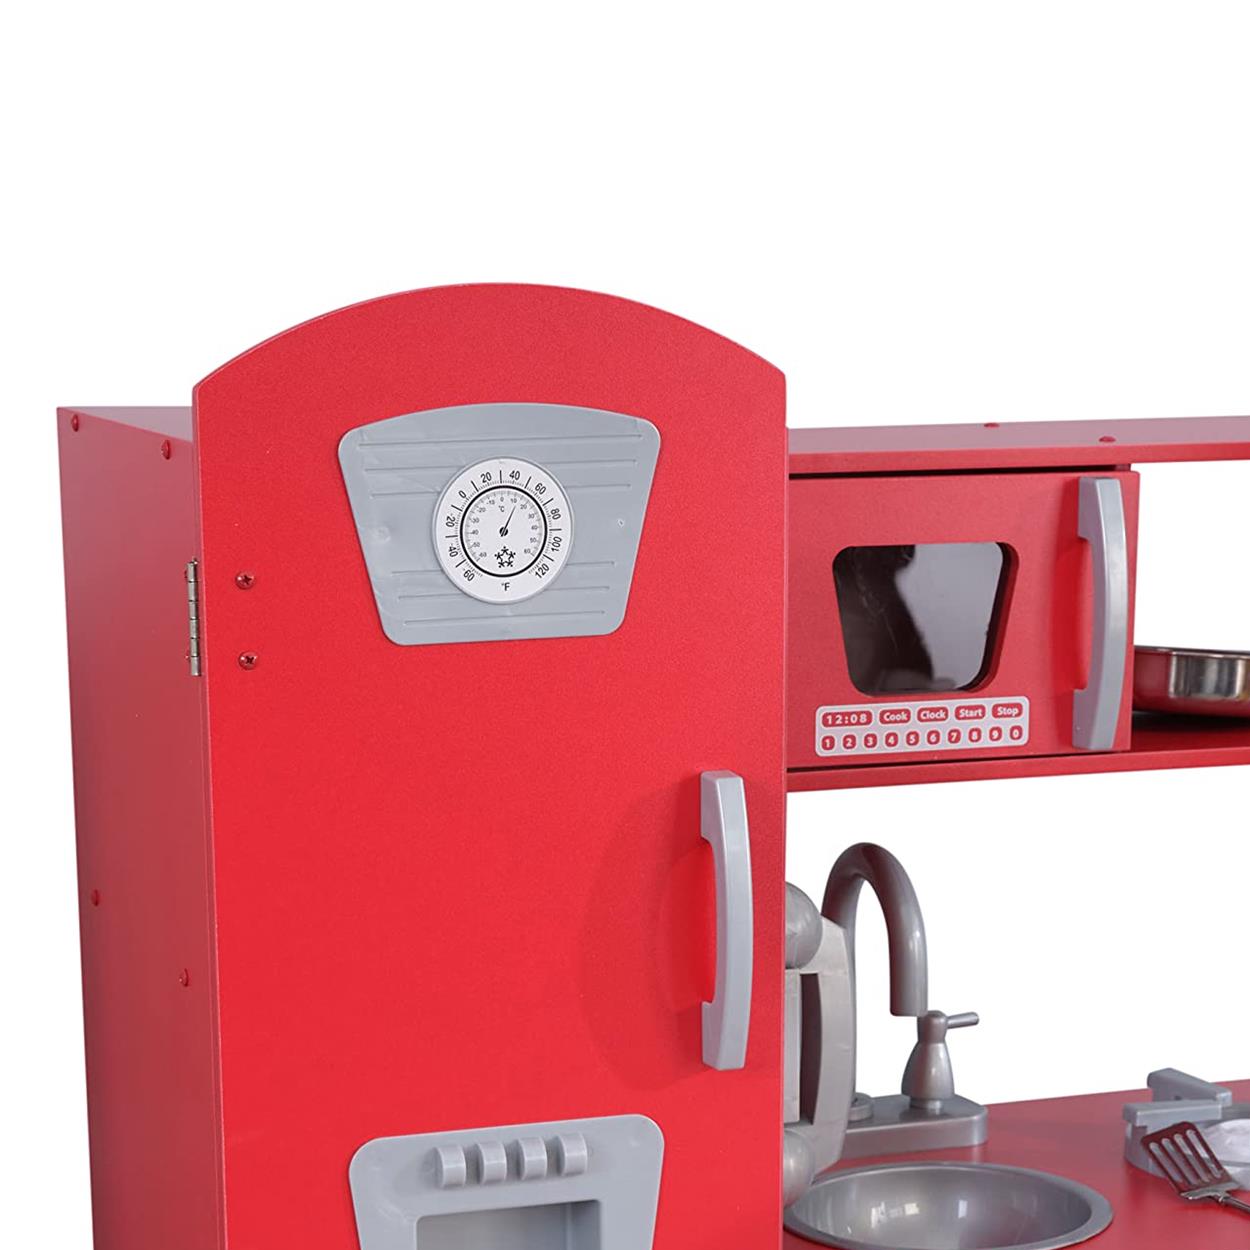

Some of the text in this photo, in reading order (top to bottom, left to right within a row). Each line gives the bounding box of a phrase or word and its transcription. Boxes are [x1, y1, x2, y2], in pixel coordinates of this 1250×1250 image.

[480, 471, 492, 484] 20
[509, 470, 521, 481] 40
[458, 490, 467, 499] 0
[535, 482, 547, 495] 60
[550, 508, 562, 520] 80
[551, 536, 562, 552] 100
[535, 563, 550, 579] 120
[826, 706, 1019, 725] 12:08 Cook Clock Start Stop
[825, 728, 1020, 748] 1 2 3 4 5 6 7 8 9 0
